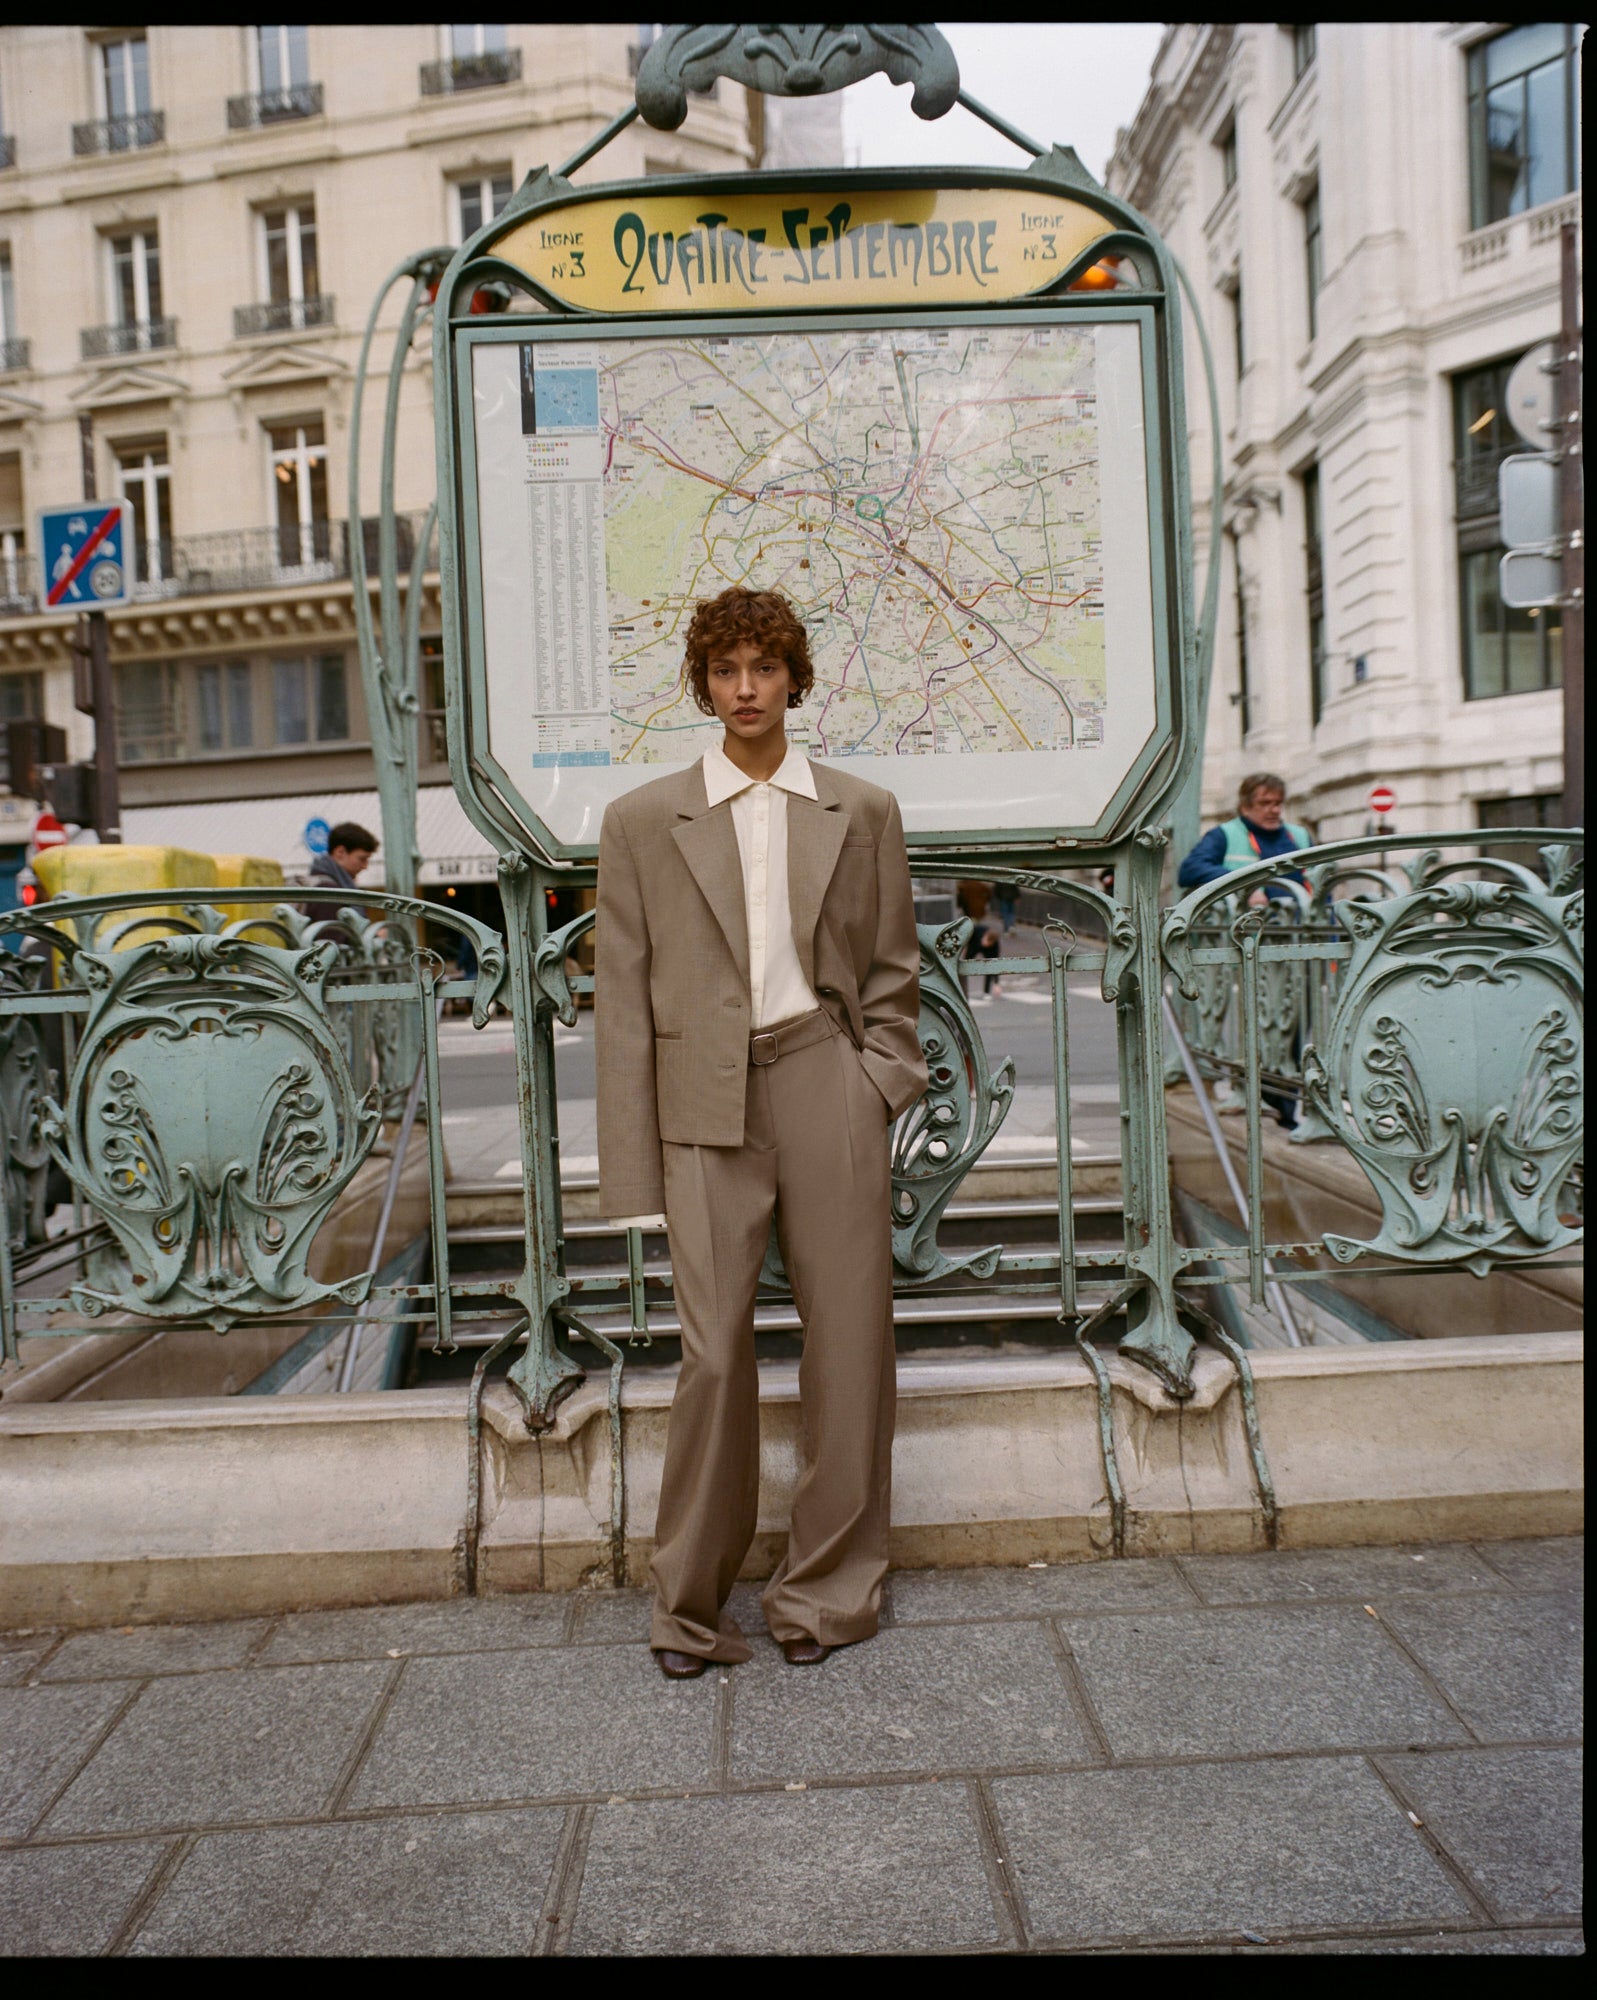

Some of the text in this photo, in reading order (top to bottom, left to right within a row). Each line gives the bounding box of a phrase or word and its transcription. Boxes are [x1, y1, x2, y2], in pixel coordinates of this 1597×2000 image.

[1020, 211, 1064, 231] LIGNE
[539, 230, 584, 249] LIGNE
[439, 863, 460, 876] BAR
